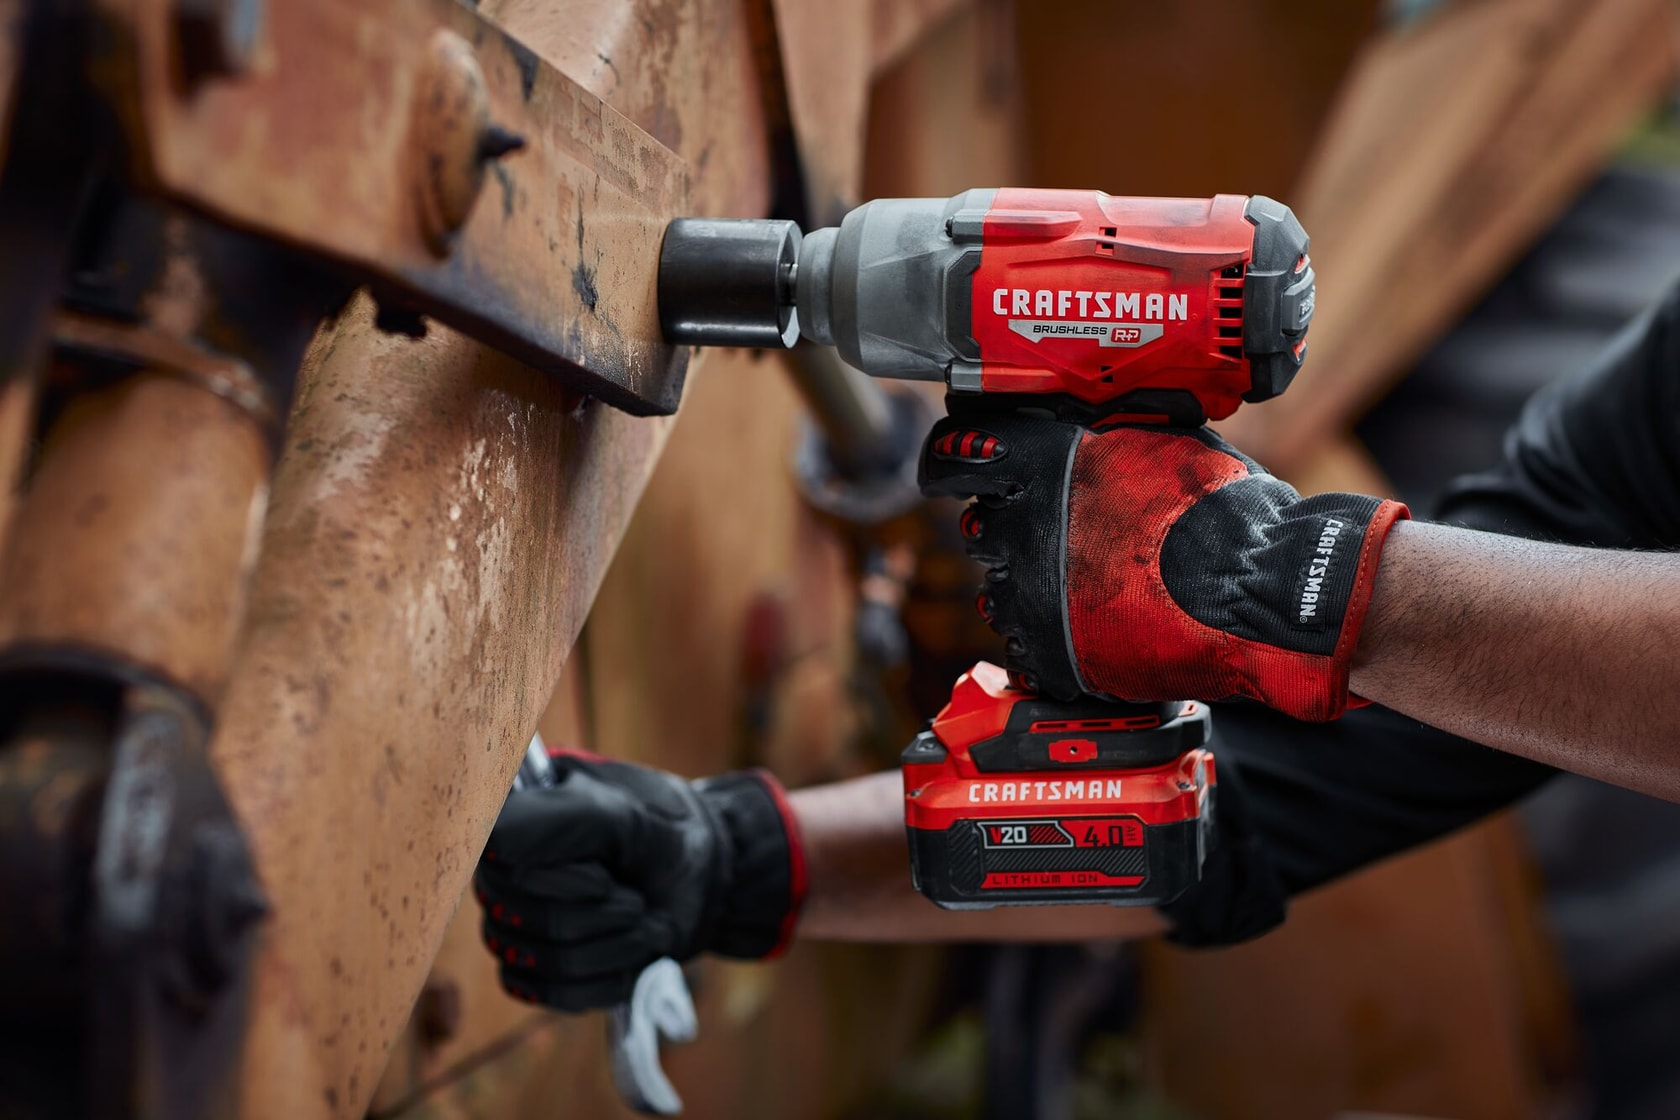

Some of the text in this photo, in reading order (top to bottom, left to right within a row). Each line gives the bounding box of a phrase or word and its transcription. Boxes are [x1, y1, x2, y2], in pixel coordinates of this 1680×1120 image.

[993, 288, 1188, 321] CRAFTSMAN
[1033, 324, 1108, 335] BRUSHLESS
[968, 780, 1122, 802] CRAFTSMAN
[990, 826, 1028, 844] V20
[1084, 825, 1123, 847] 4.0
[992, 873, 1099, 884] LITHIUM ION
